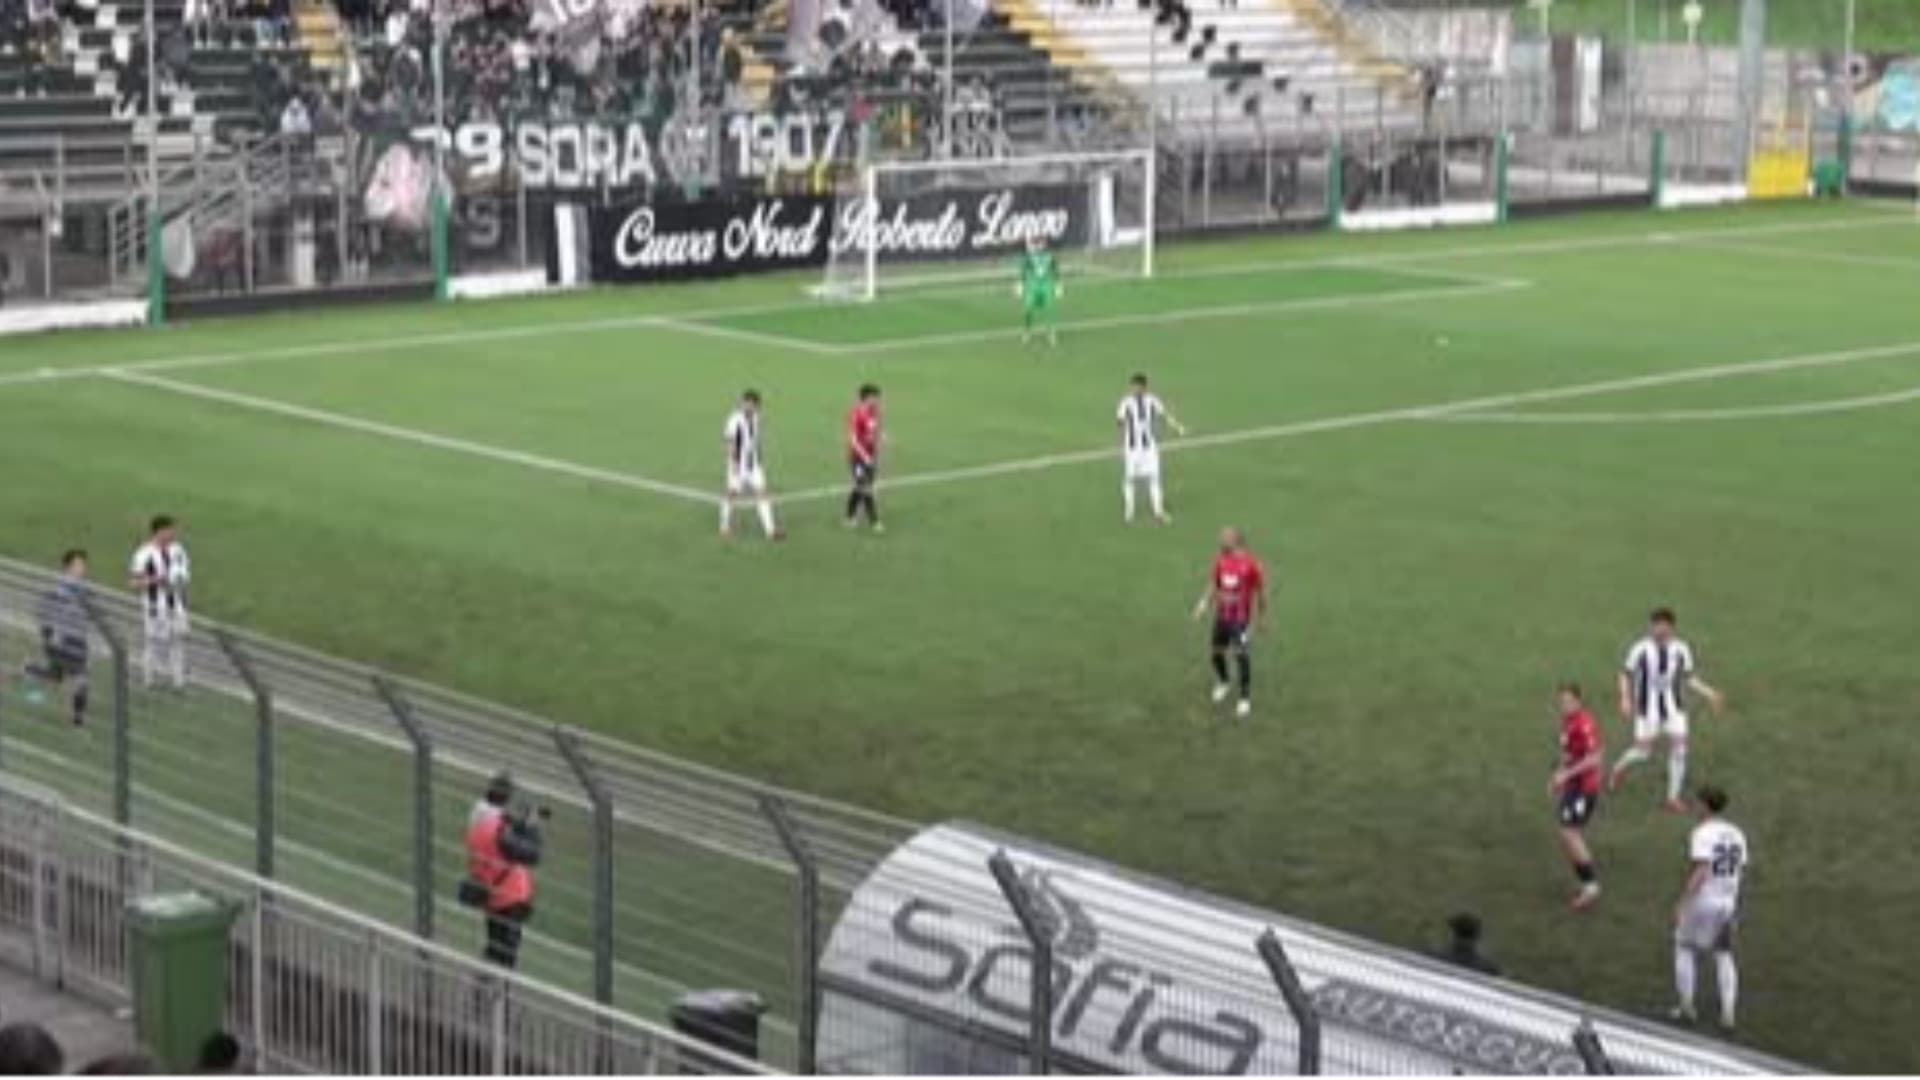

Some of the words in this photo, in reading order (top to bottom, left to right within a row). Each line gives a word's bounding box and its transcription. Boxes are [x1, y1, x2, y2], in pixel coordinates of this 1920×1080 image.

[516, 121, 656, 187] SORA
[727, 110, 845, 178] 1907
[615, 206, 717, 267] Curva
[723, 198, 824, 261] Nord
[829, 195, 966, 253] Roberto
[867, 897, 1265, 1076] Sofia
